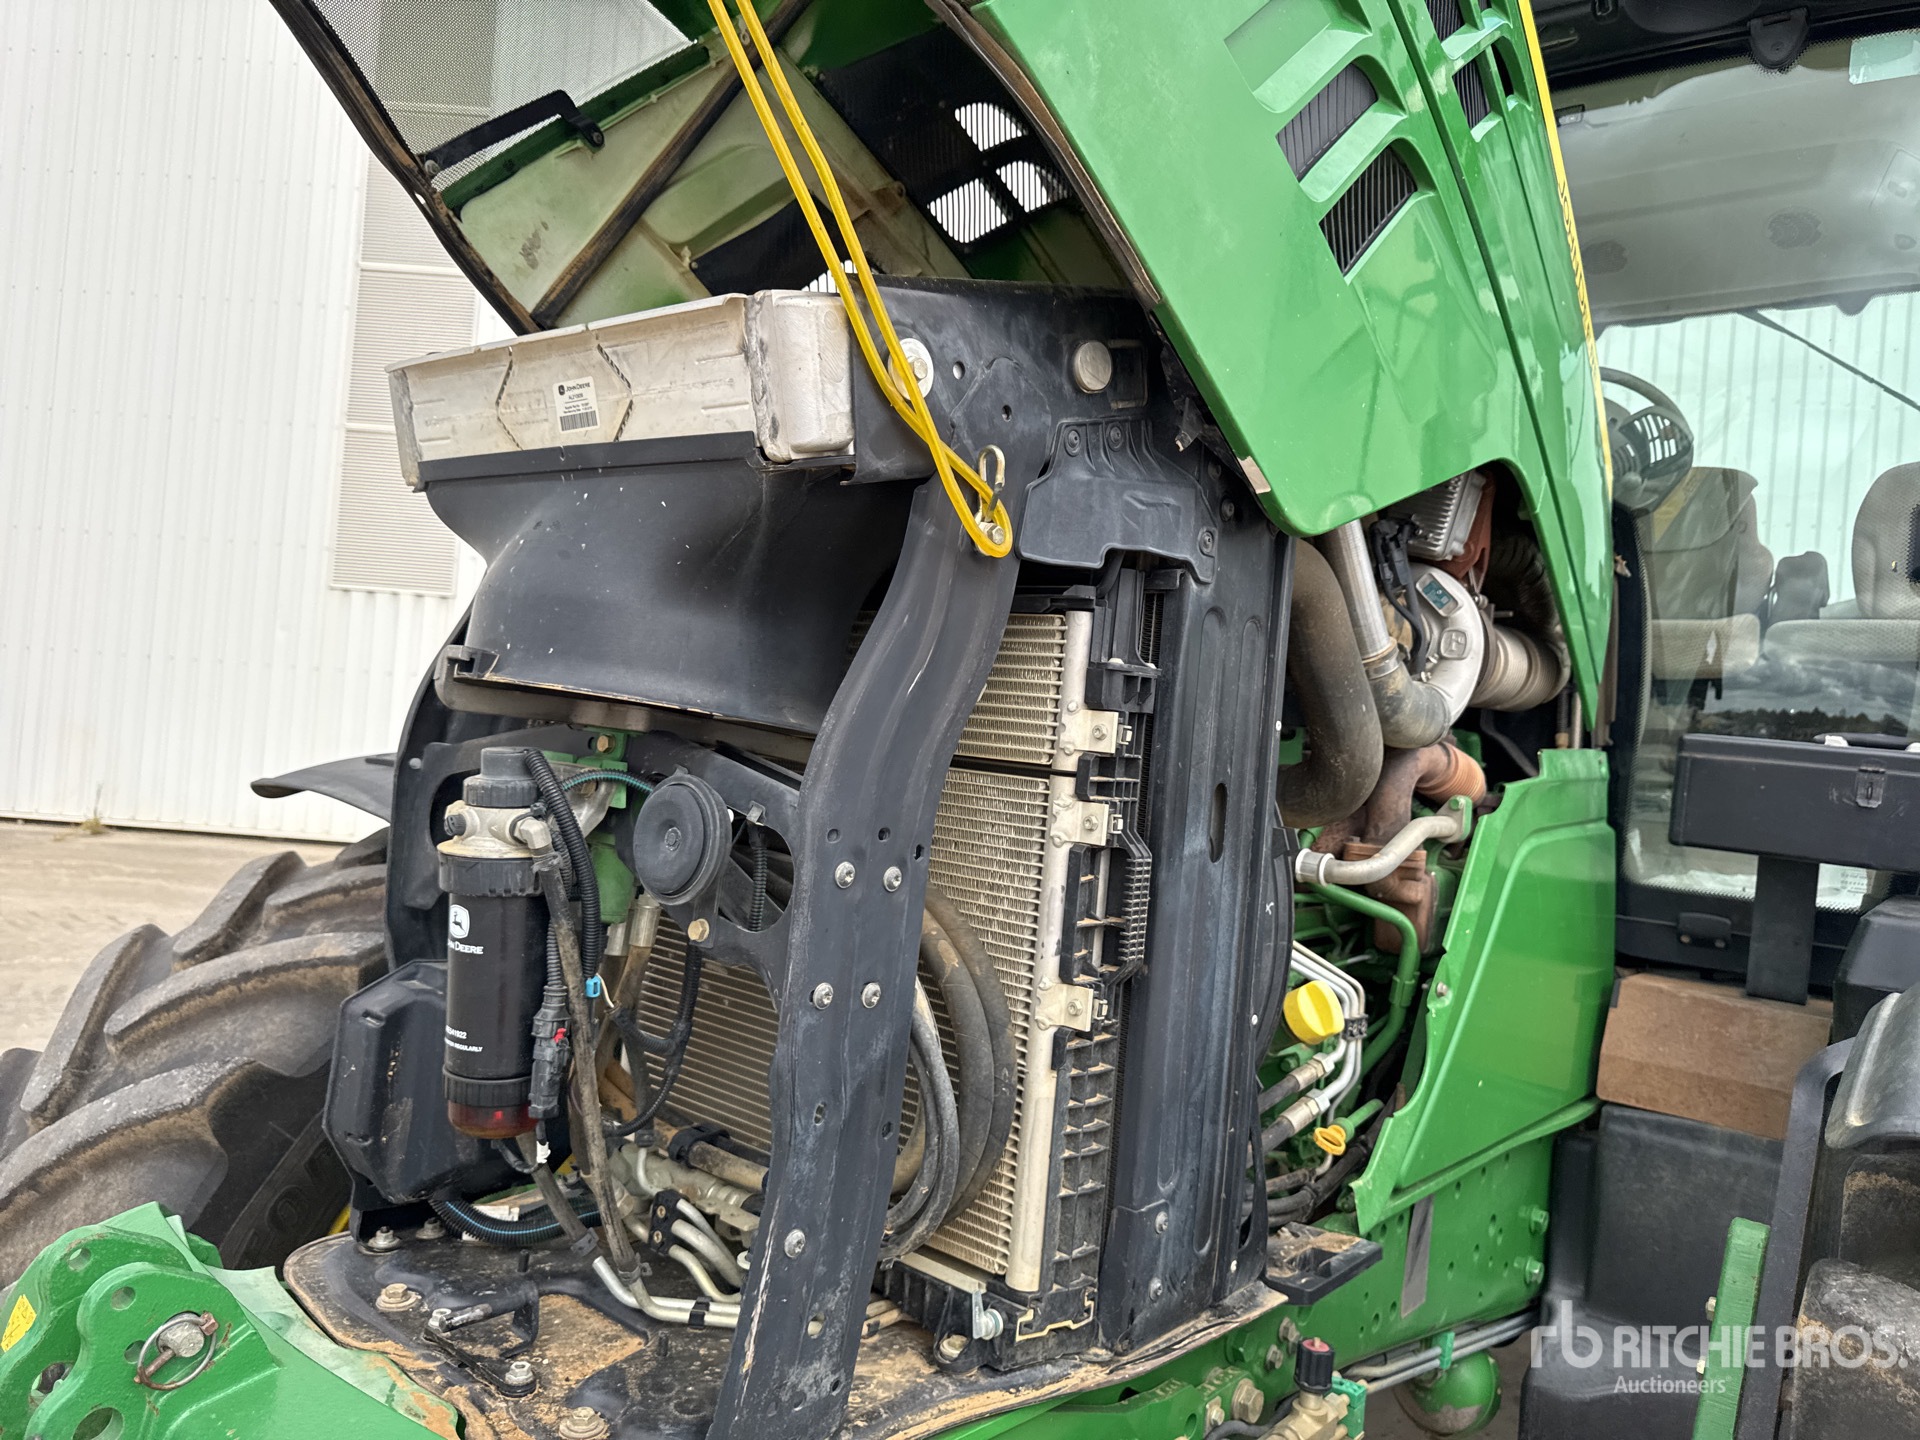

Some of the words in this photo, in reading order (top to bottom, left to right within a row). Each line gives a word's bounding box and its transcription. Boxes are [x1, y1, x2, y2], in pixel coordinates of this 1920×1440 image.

[576, 382, 591, 390] DEERE
[454, 941, 484, 954] DEERE
[454, 1043, 483, 1053] REGULARLY
